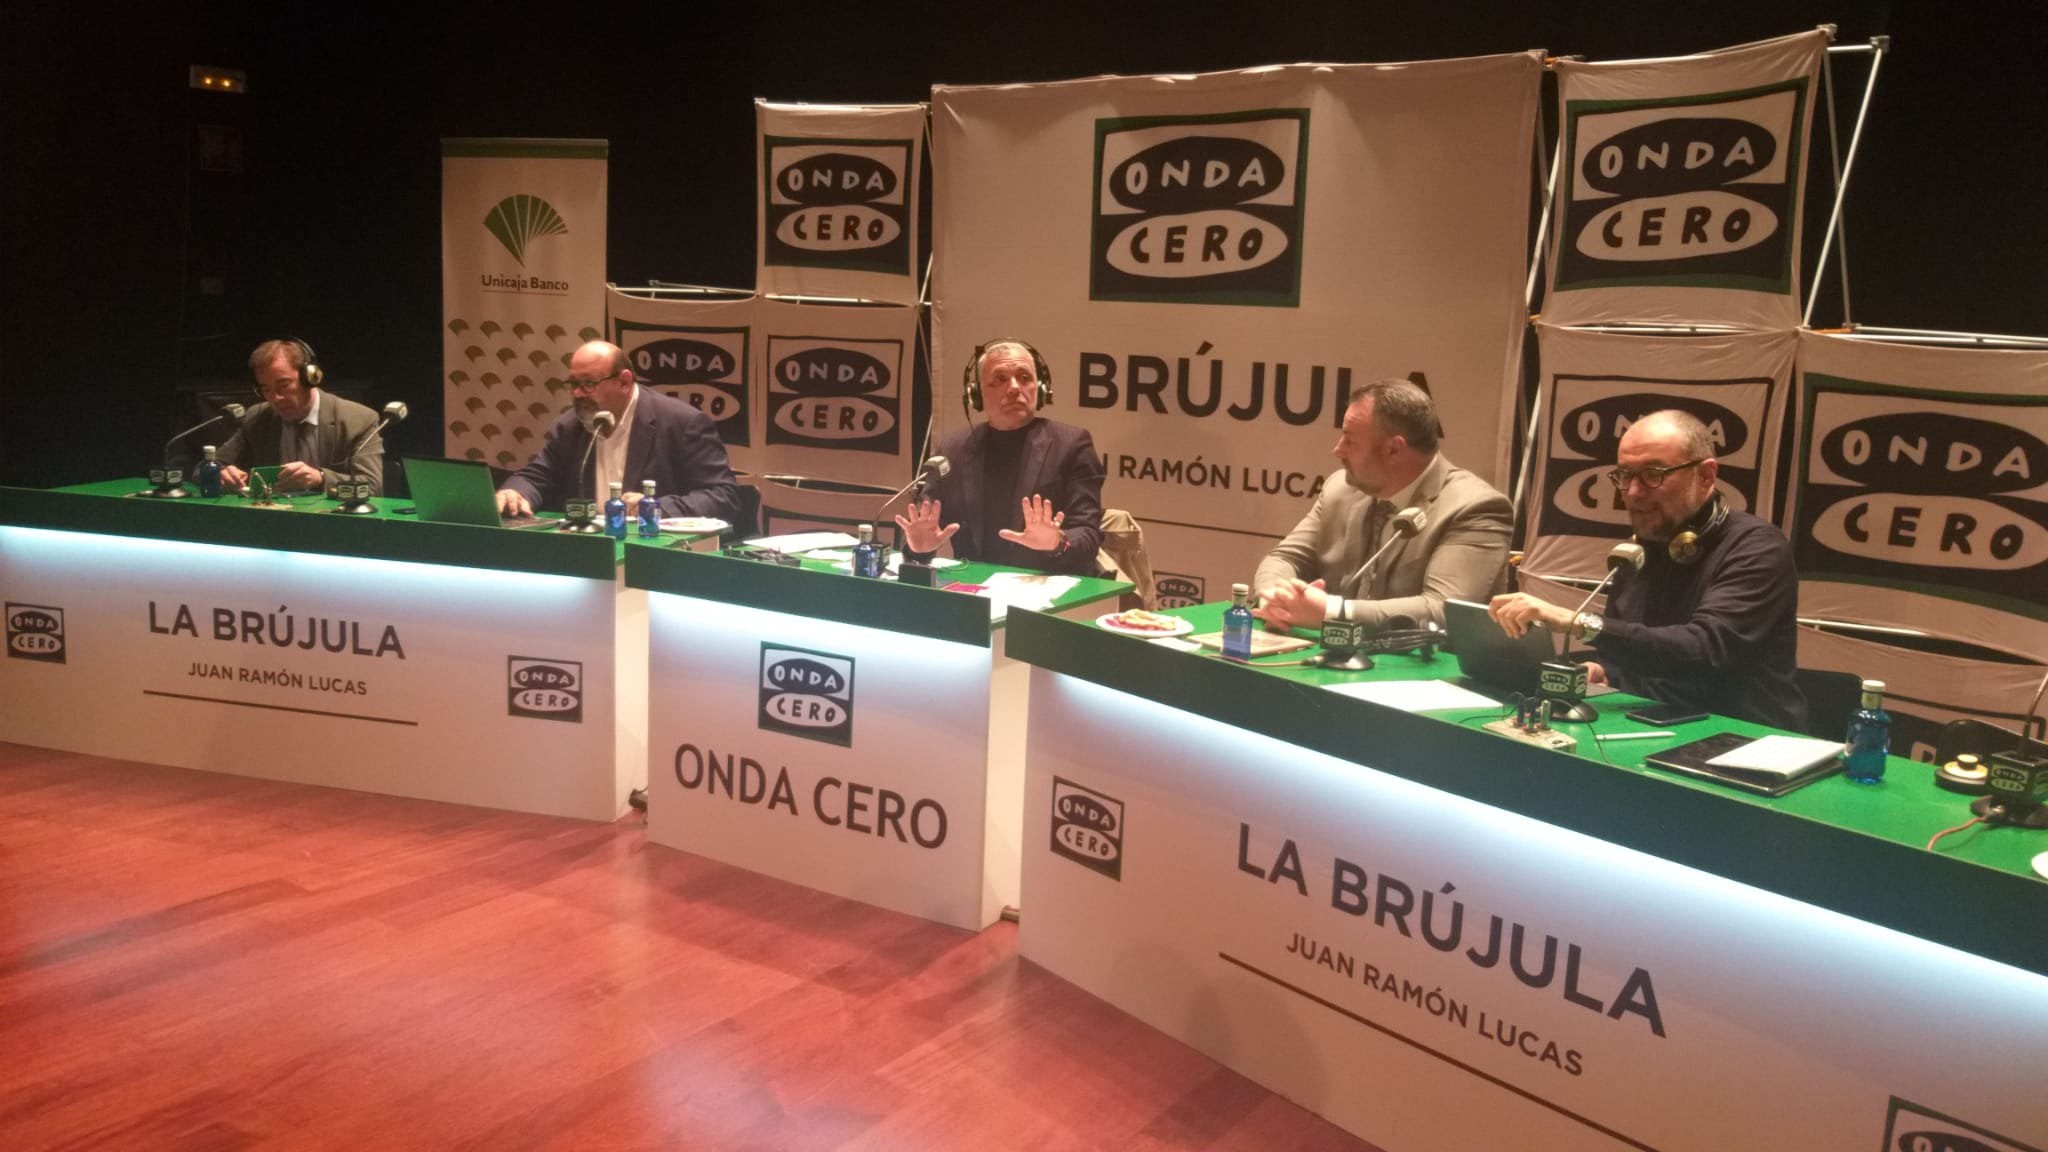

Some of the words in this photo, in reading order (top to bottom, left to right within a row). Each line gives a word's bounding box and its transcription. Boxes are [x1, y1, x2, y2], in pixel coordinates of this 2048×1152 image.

[1599, 136, 1756, 179] ONDA
[787, 168, 886, 191] ONDA
[1125, 157, 1267, 196] ONDA
[792, 213, 884, 242] CERO
[1602, 206, 1752, 249] CERO
[1129, 224, 1264, 265] CERO
[481, 273, 528, 291] Unicaja
[530, 276, 569, 291] Banco
[637, 350, 725, 373] ONDA
[785, 361, 882, 385] ONDA
[790, 402, 877, 431] CERO
[1842, 429, 2031, 480] ONDA
[1118, 455, 1231, 490] RAMÓN
[1242, 467, 1325, 500] LUCA
[1843, 501, 2025, 561] CERO
[1160, 582, 1196, 594] ONDA
[15, 615, 55, 630] ONDA
[149, 600, 199, 639] LA
[212, 604, 406, 660] BRÚJULA
[18, 636, 56, 651] CERO
[188, 662, 233, 681] JUAN
[238, 667, 303, 689] RAMÓN
[308, 675, 368, 696] LUCAS
[520, 670, 570, 685] ONDA
[774, 664, 838, 690] ONDA
[523, 692, 570, 708] CERO
[776, 697, 836, 723] CERO
[674, 743, 799, 818] ONDA
[813, 776, 948, 850] CERO
[1062, 798, 1111, 828] ONDA
[1064, 826, 1110, 857] CERO
[1237, 822, 1309, 898] LA
[1330, 857, 1668, 1040] BRÚJULA
[1285, 930, 1355, 979] JUAN
[1362, 963, 1469, 1029] RAMÓN
[1477, 1011, 1584, 1077] LUCAS
